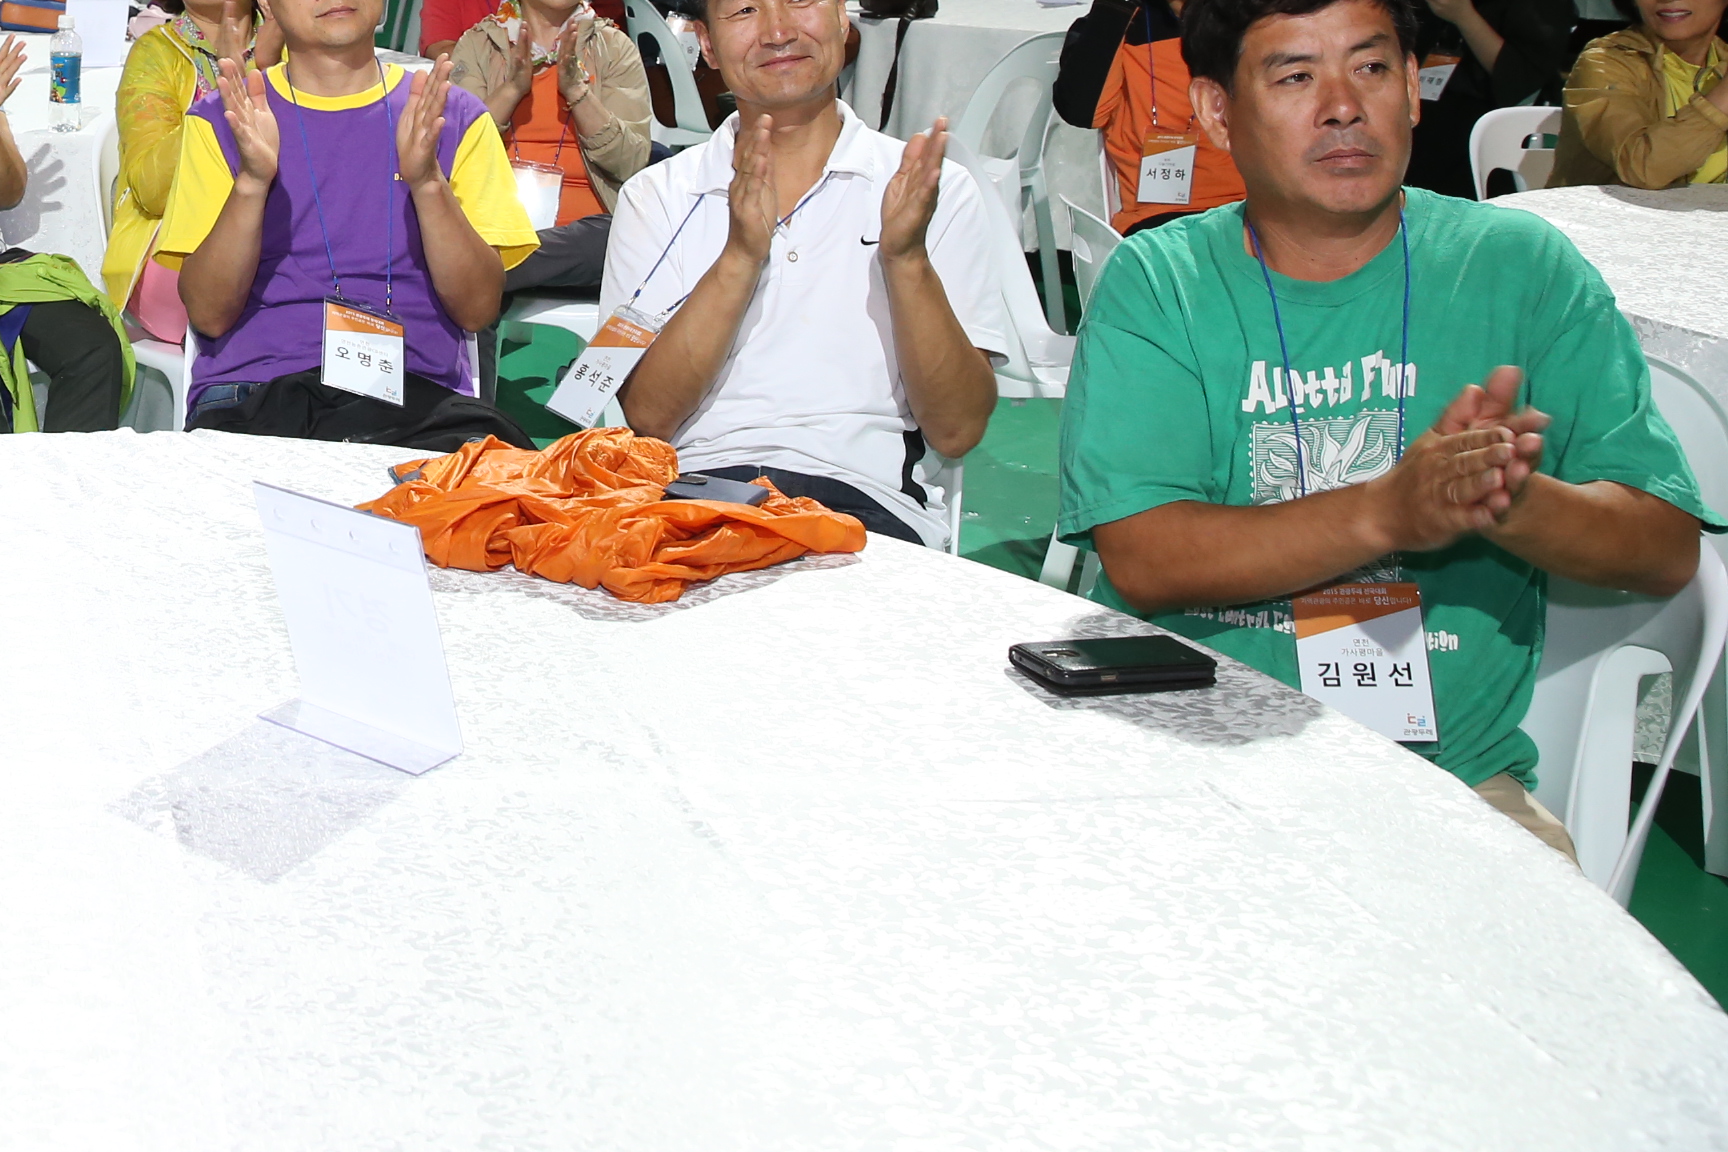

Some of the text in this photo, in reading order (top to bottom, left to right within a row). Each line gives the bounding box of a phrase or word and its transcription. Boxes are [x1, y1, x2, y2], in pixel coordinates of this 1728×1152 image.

[334, 346, 394, 375] 오명춘
[573, 363, 615, 394] 홍석준
[1340, 647, 1384, 657] 가사평마을
[1352, 638, 1370, 647] 연천
[1318, 661, 1415, 688] 김원선
